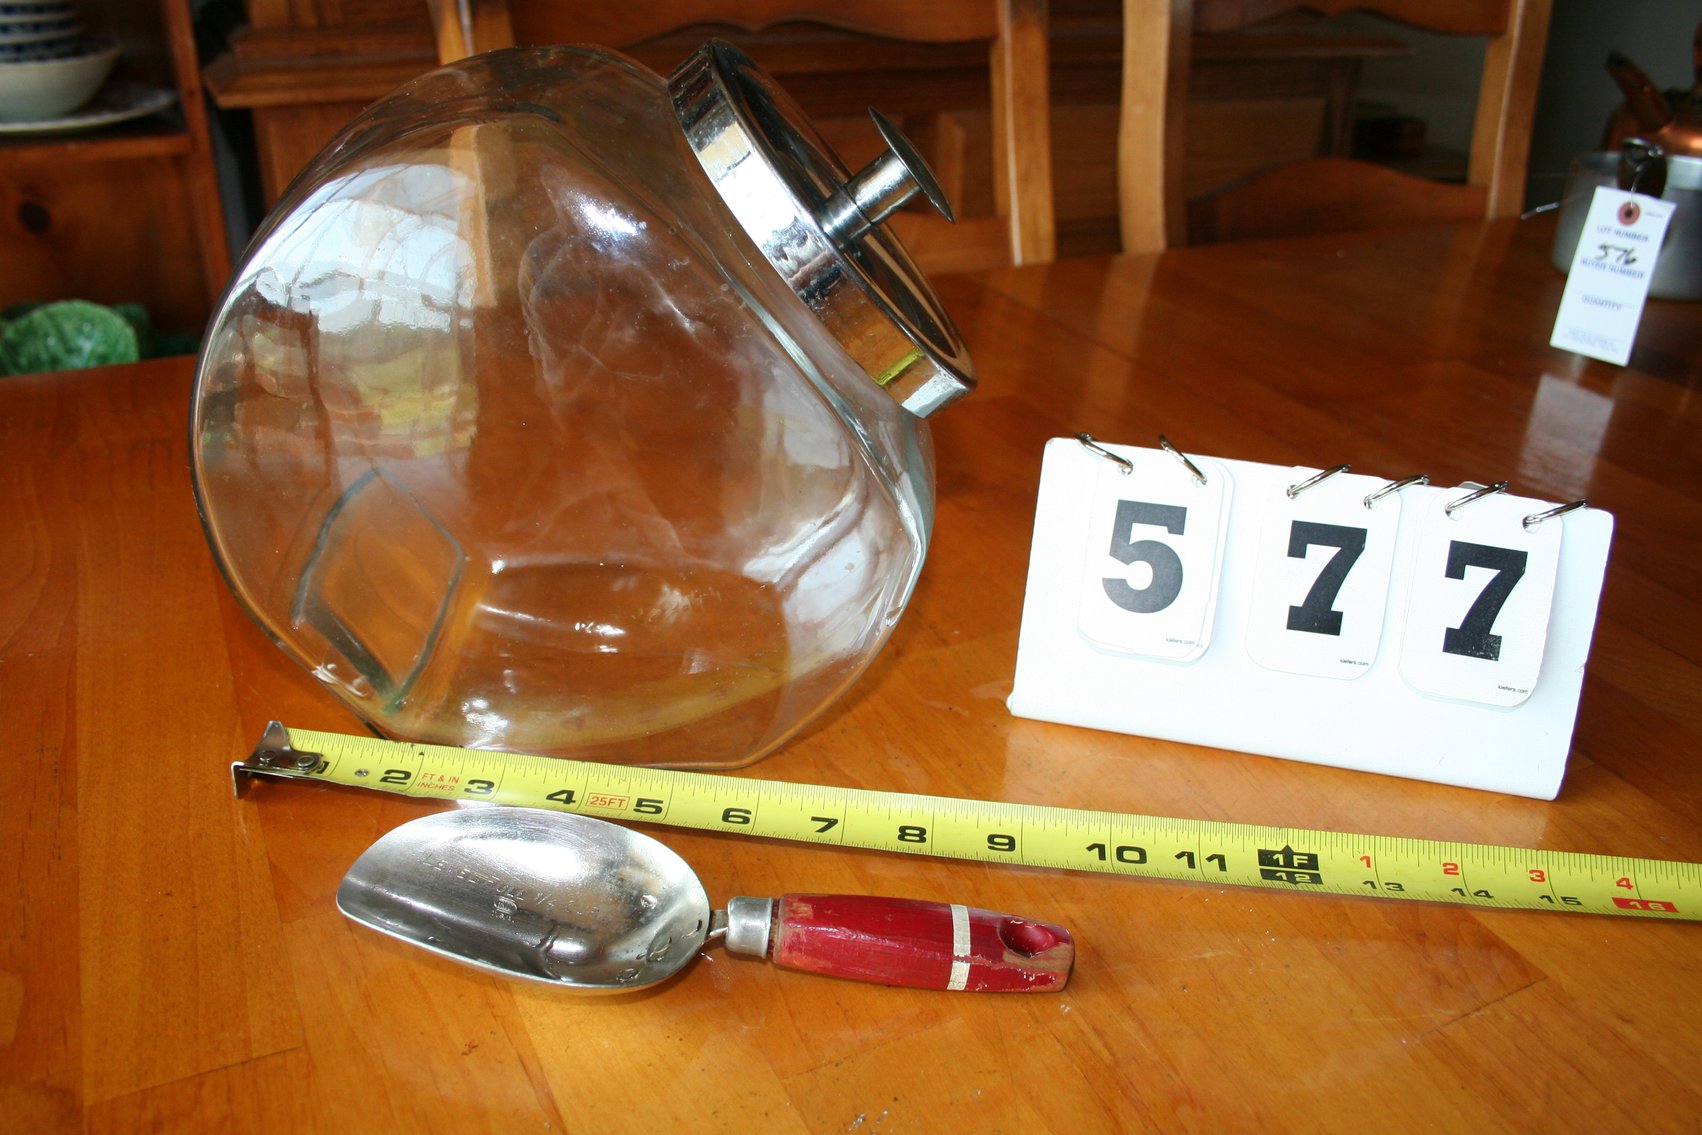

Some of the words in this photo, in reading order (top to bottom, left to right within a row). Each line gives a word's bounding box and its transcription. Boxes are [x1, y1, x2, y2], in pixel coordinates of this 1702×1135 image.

[1613, 228, 1650, 243] NUMBER
[1594, 242, 1639, 266] 576
[1608, 264, 1646, 280] NUMBER
[417, 780, 456, 793] INCHES
[422, 772, 436, 783] FT
[436, 774, 447, 784] &
[448, 775, 461, 785] IN
[589, 795, 626, 809] 25FT
[379, 768, 412, 785] 2
[464, 779, 496, 796] 3
[545, 788, 577, 805] 4
[632, 797, 664, 815] 5
[721, 807, 753, 825] 6
[810, 816, 839, 834] 7
[896, 825, 927, 845] 8
[986, 833, 1017, 853] 9
[1085, 843, 1149, 865] 10
[1272, 852, 1310, 868] 1F
[1275, 871, 1313, 884] 12
[1360, 854, 1372, 868] 1
[1442, 861, 1460, 877] 2
[1529, 868, 1546, 883] 3
[1616, 876, 1633, 890] 4
[1362, 880, 1405, 893] 13
[1451, 886, 1494, 899] 14
[1538, 894, 1583, 907] 15
[1627, 900, 1667, 912] 16
